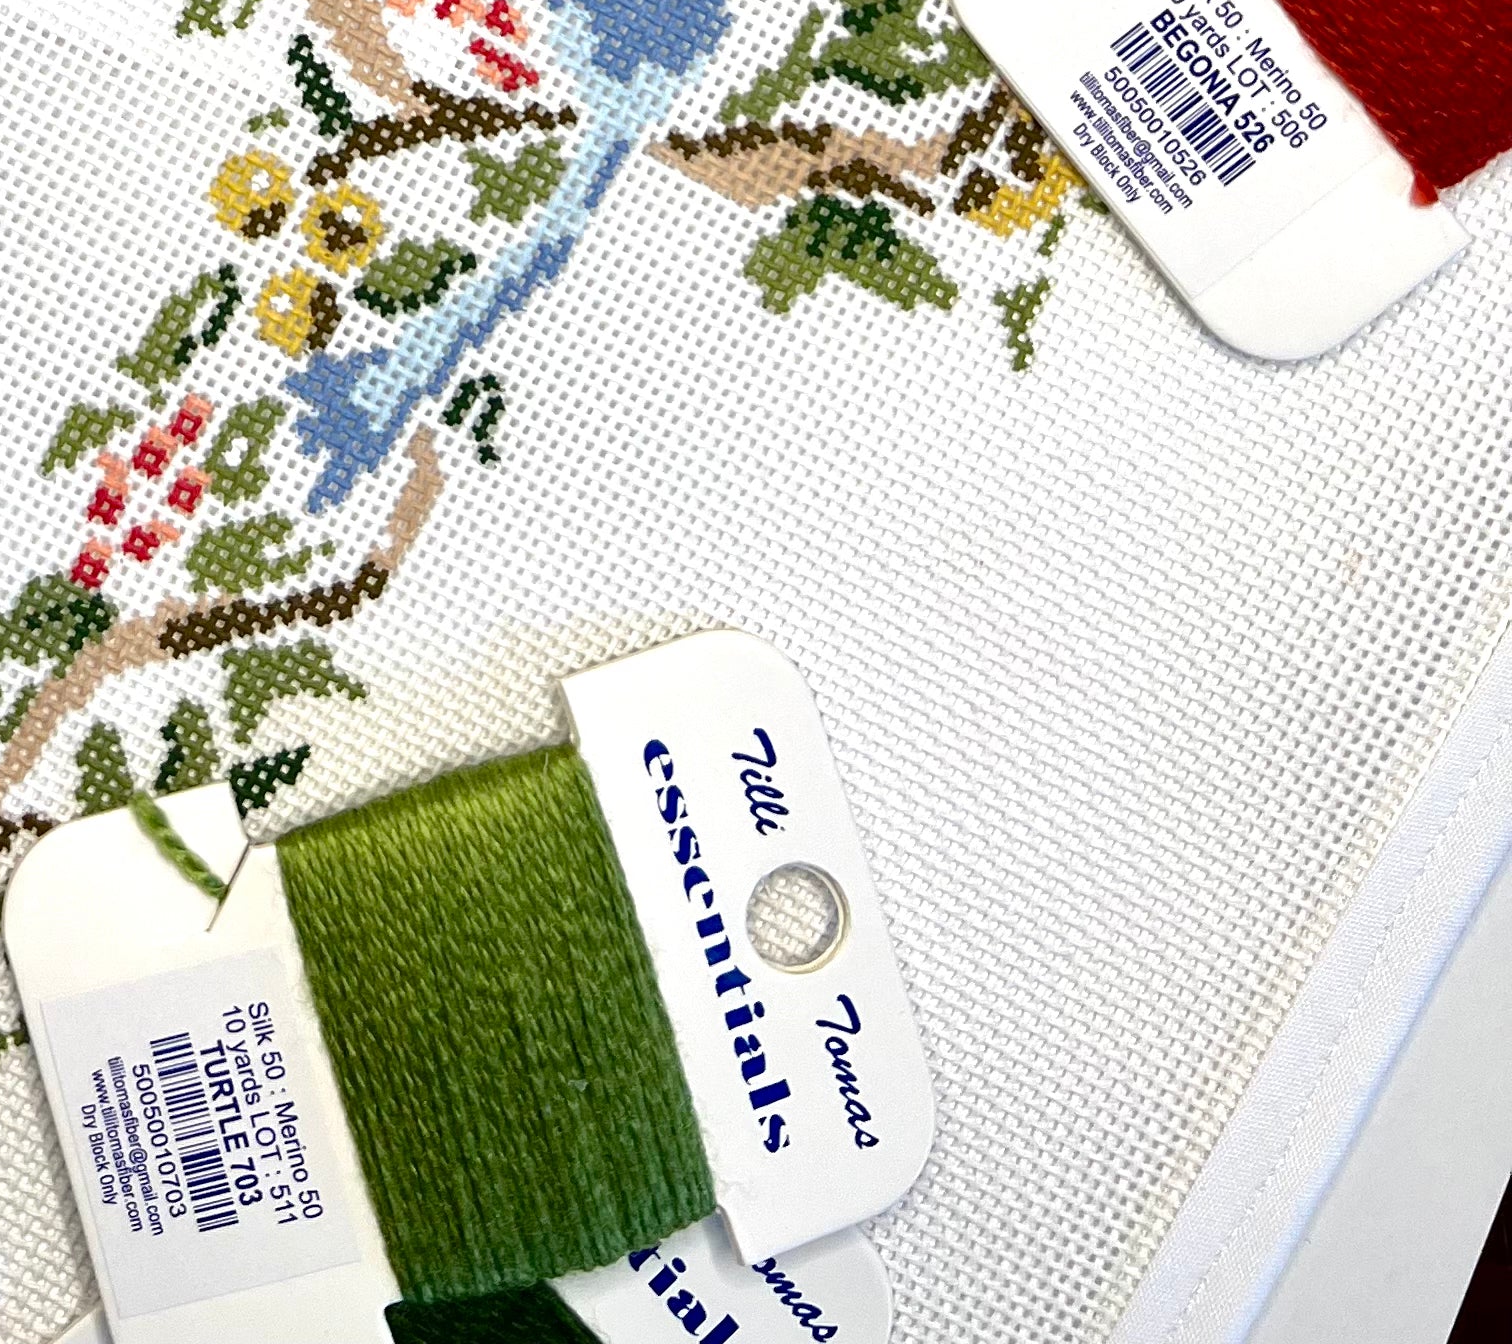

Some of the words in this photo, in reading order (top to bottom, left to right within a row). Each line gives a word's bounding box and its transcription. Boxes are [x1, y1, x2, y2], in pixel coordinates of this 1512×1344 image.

[1150, 9, 1241, 116] BEGONIA
[1234, 110, 1276, 154] 526
[1179, 4, 1231, 59] yards
[1226, 54, 1272, 99] LOT
[1271, 109, 1310, 149] 506
[1215, 0, 1244, 29] 50
[1245, 37, 1302, 105] Merino
[1299, 102, 1328, 131] 50
[1073, 122, 1096, 148] Dry
[1090, 143, 1121, 180] Block
[1116, 175, 1142, 204] Only
[1104, 66, 1208, 187] 50050010526
[643, 739, 791, 1153] essentials
[731, 727, 790, 836] Tilli
[816, 993, 880, 1149] Tomas
[223, 1005, 247, 1034] 10
[248, 1002, 276, 1047] Silk
[226, 1039, 264, 1106] yards
[261, 1051, 286, 1081] 50
[81, 1104, 99, 1129] Dry
[88, 1132, 111, 1173] Block
[132, 1064, 188, 1219] 50050010703
[200, 1039, 250, 1154] TURTLE
[231, 1156, 263, 1207] 703
[249, 1111, 283, 1162] LOT
[274, 1101, 309, 1184] Merino
[99, 1174, 118, 1205] Only
[269, 1184, 299, 1225] 511
[298, 1189, 324, 1220] 50
